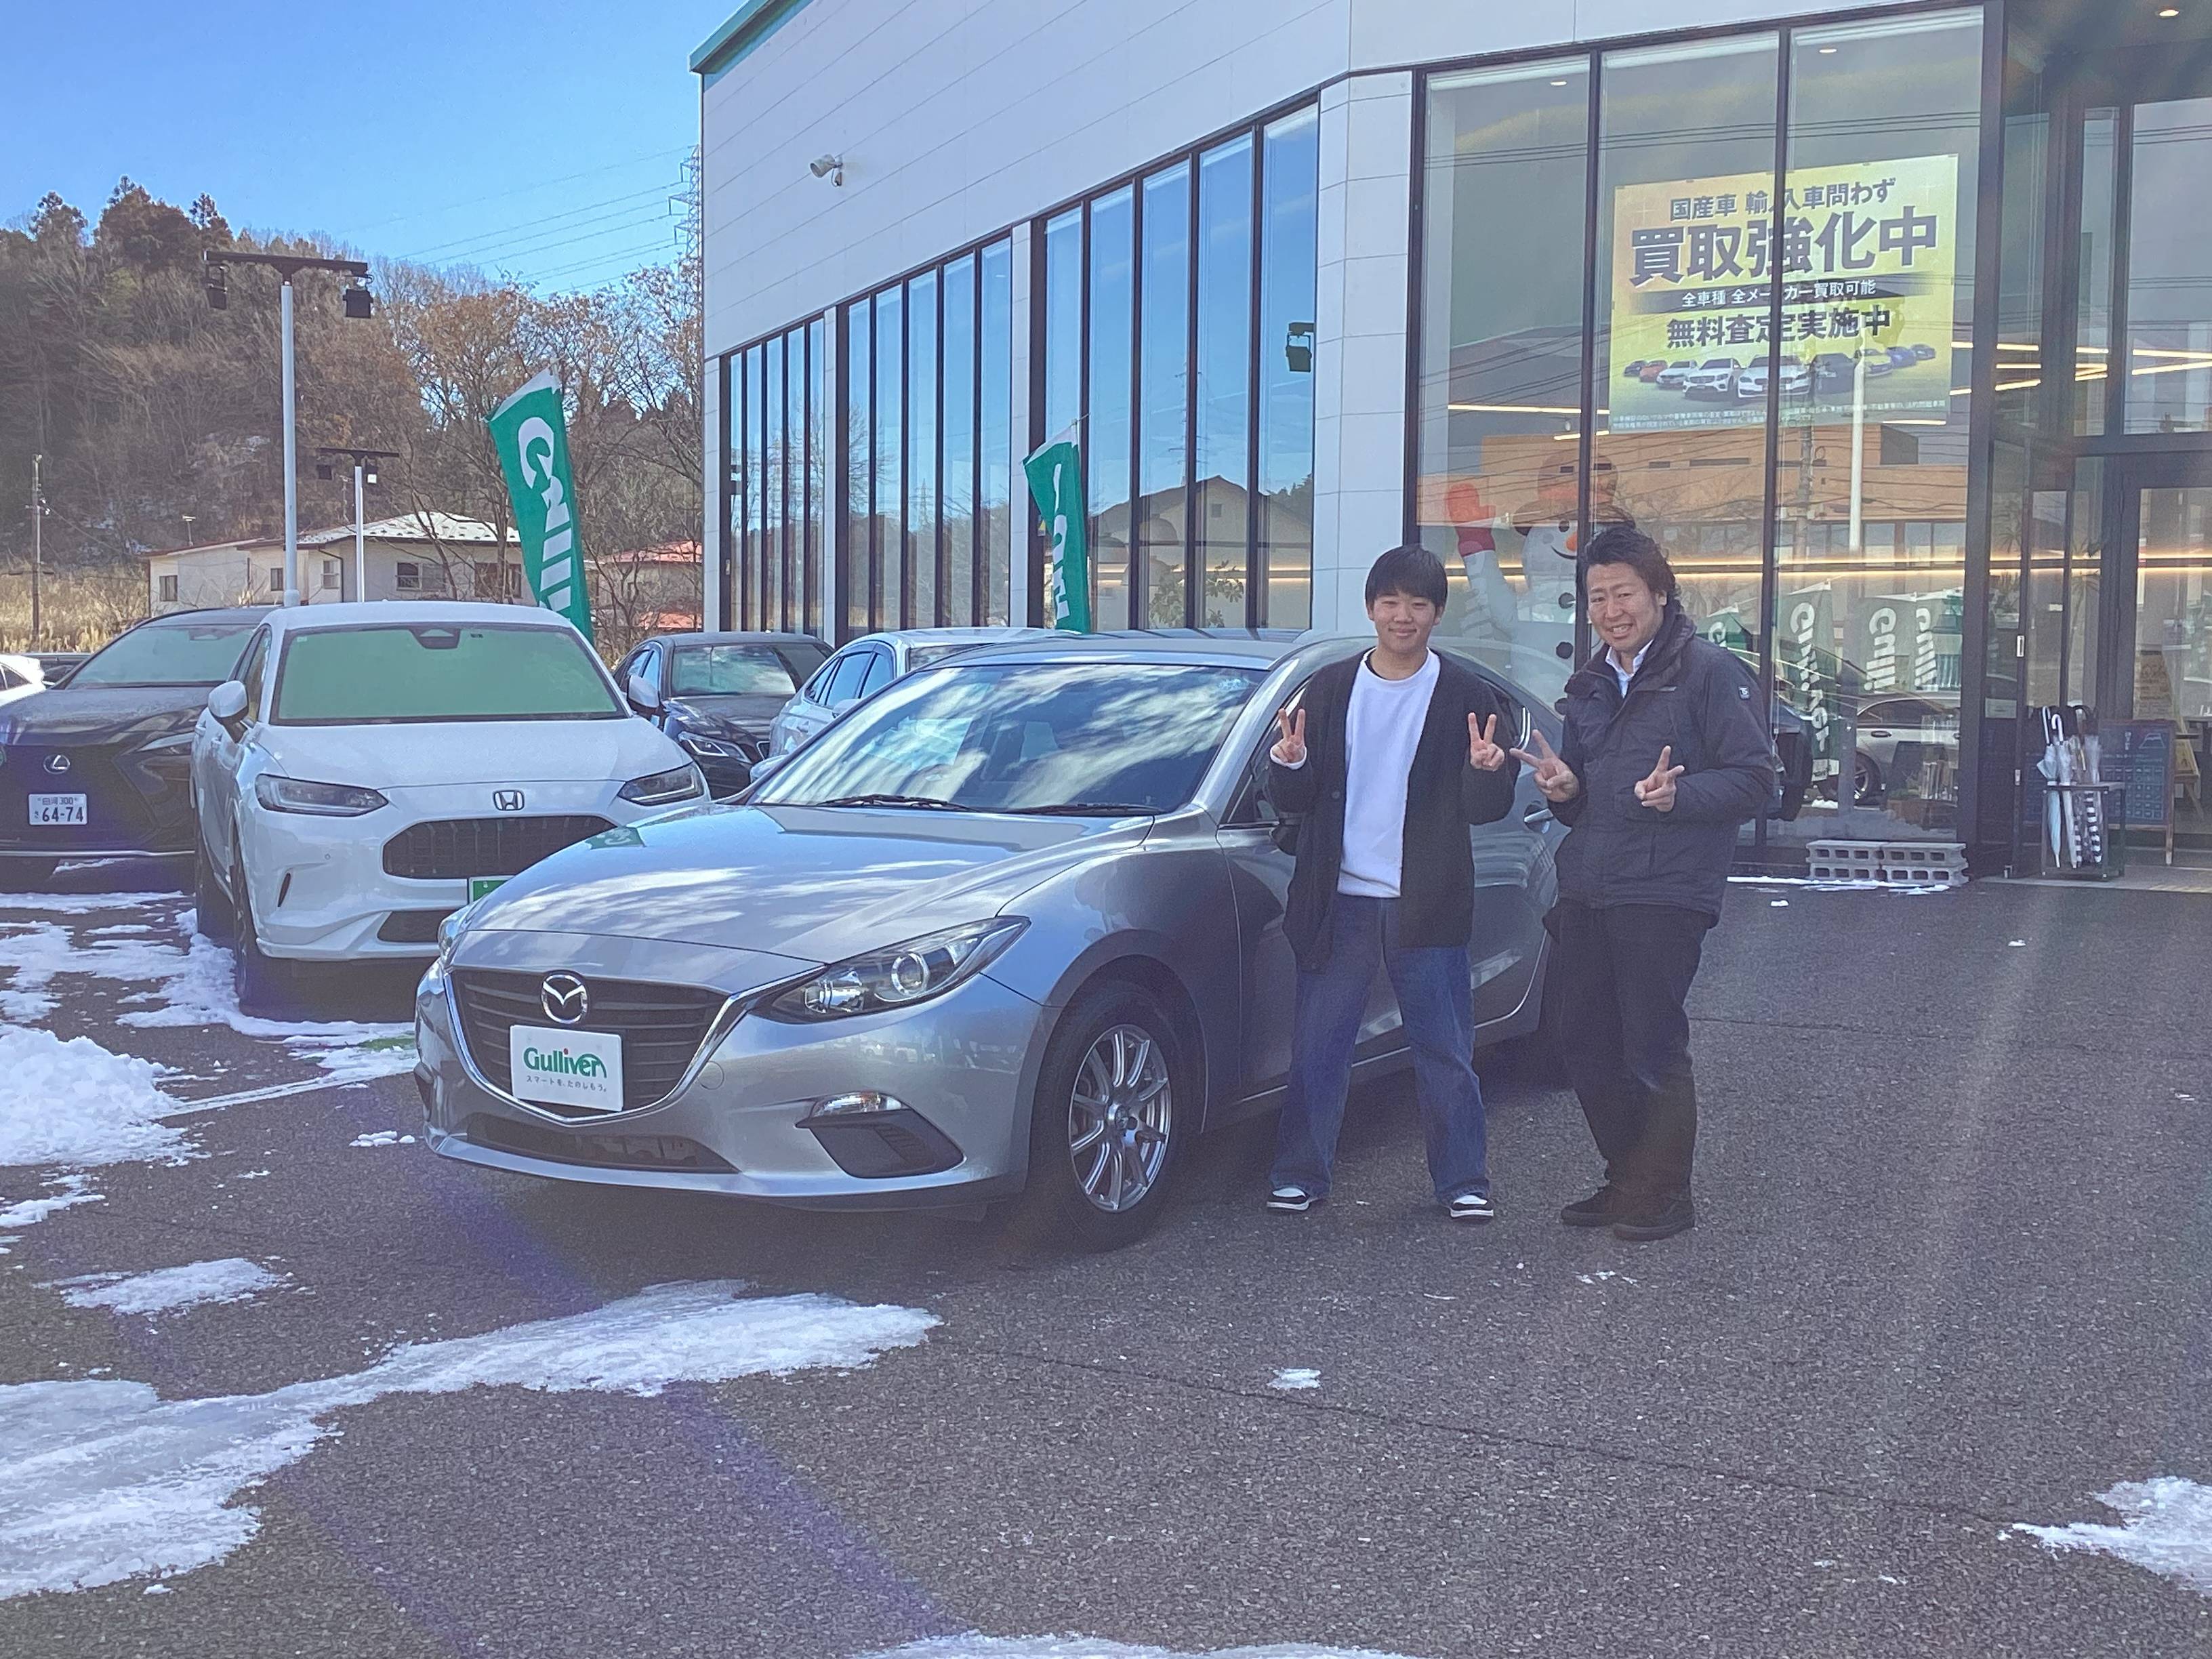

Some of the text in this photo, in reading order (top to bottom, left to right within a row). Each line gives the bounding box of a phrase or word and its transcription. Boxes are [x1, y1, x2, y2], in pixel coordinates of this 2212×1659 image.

[1670, 177, 1896, 222] 国産車 輸入車問わず
[1629, 205, 1938, 287] 買取強化中
[1681, 279, 1877, 308] 全車種 全メーカー買取可能
[1666, 304, 1891, 349] 無料査定実施中
[42, 806, 83, 822] 64-74
[523, 1046, 607, 1079] Gulliver
[526, 1075, 607, 1092] スマートを、たのしもう。
